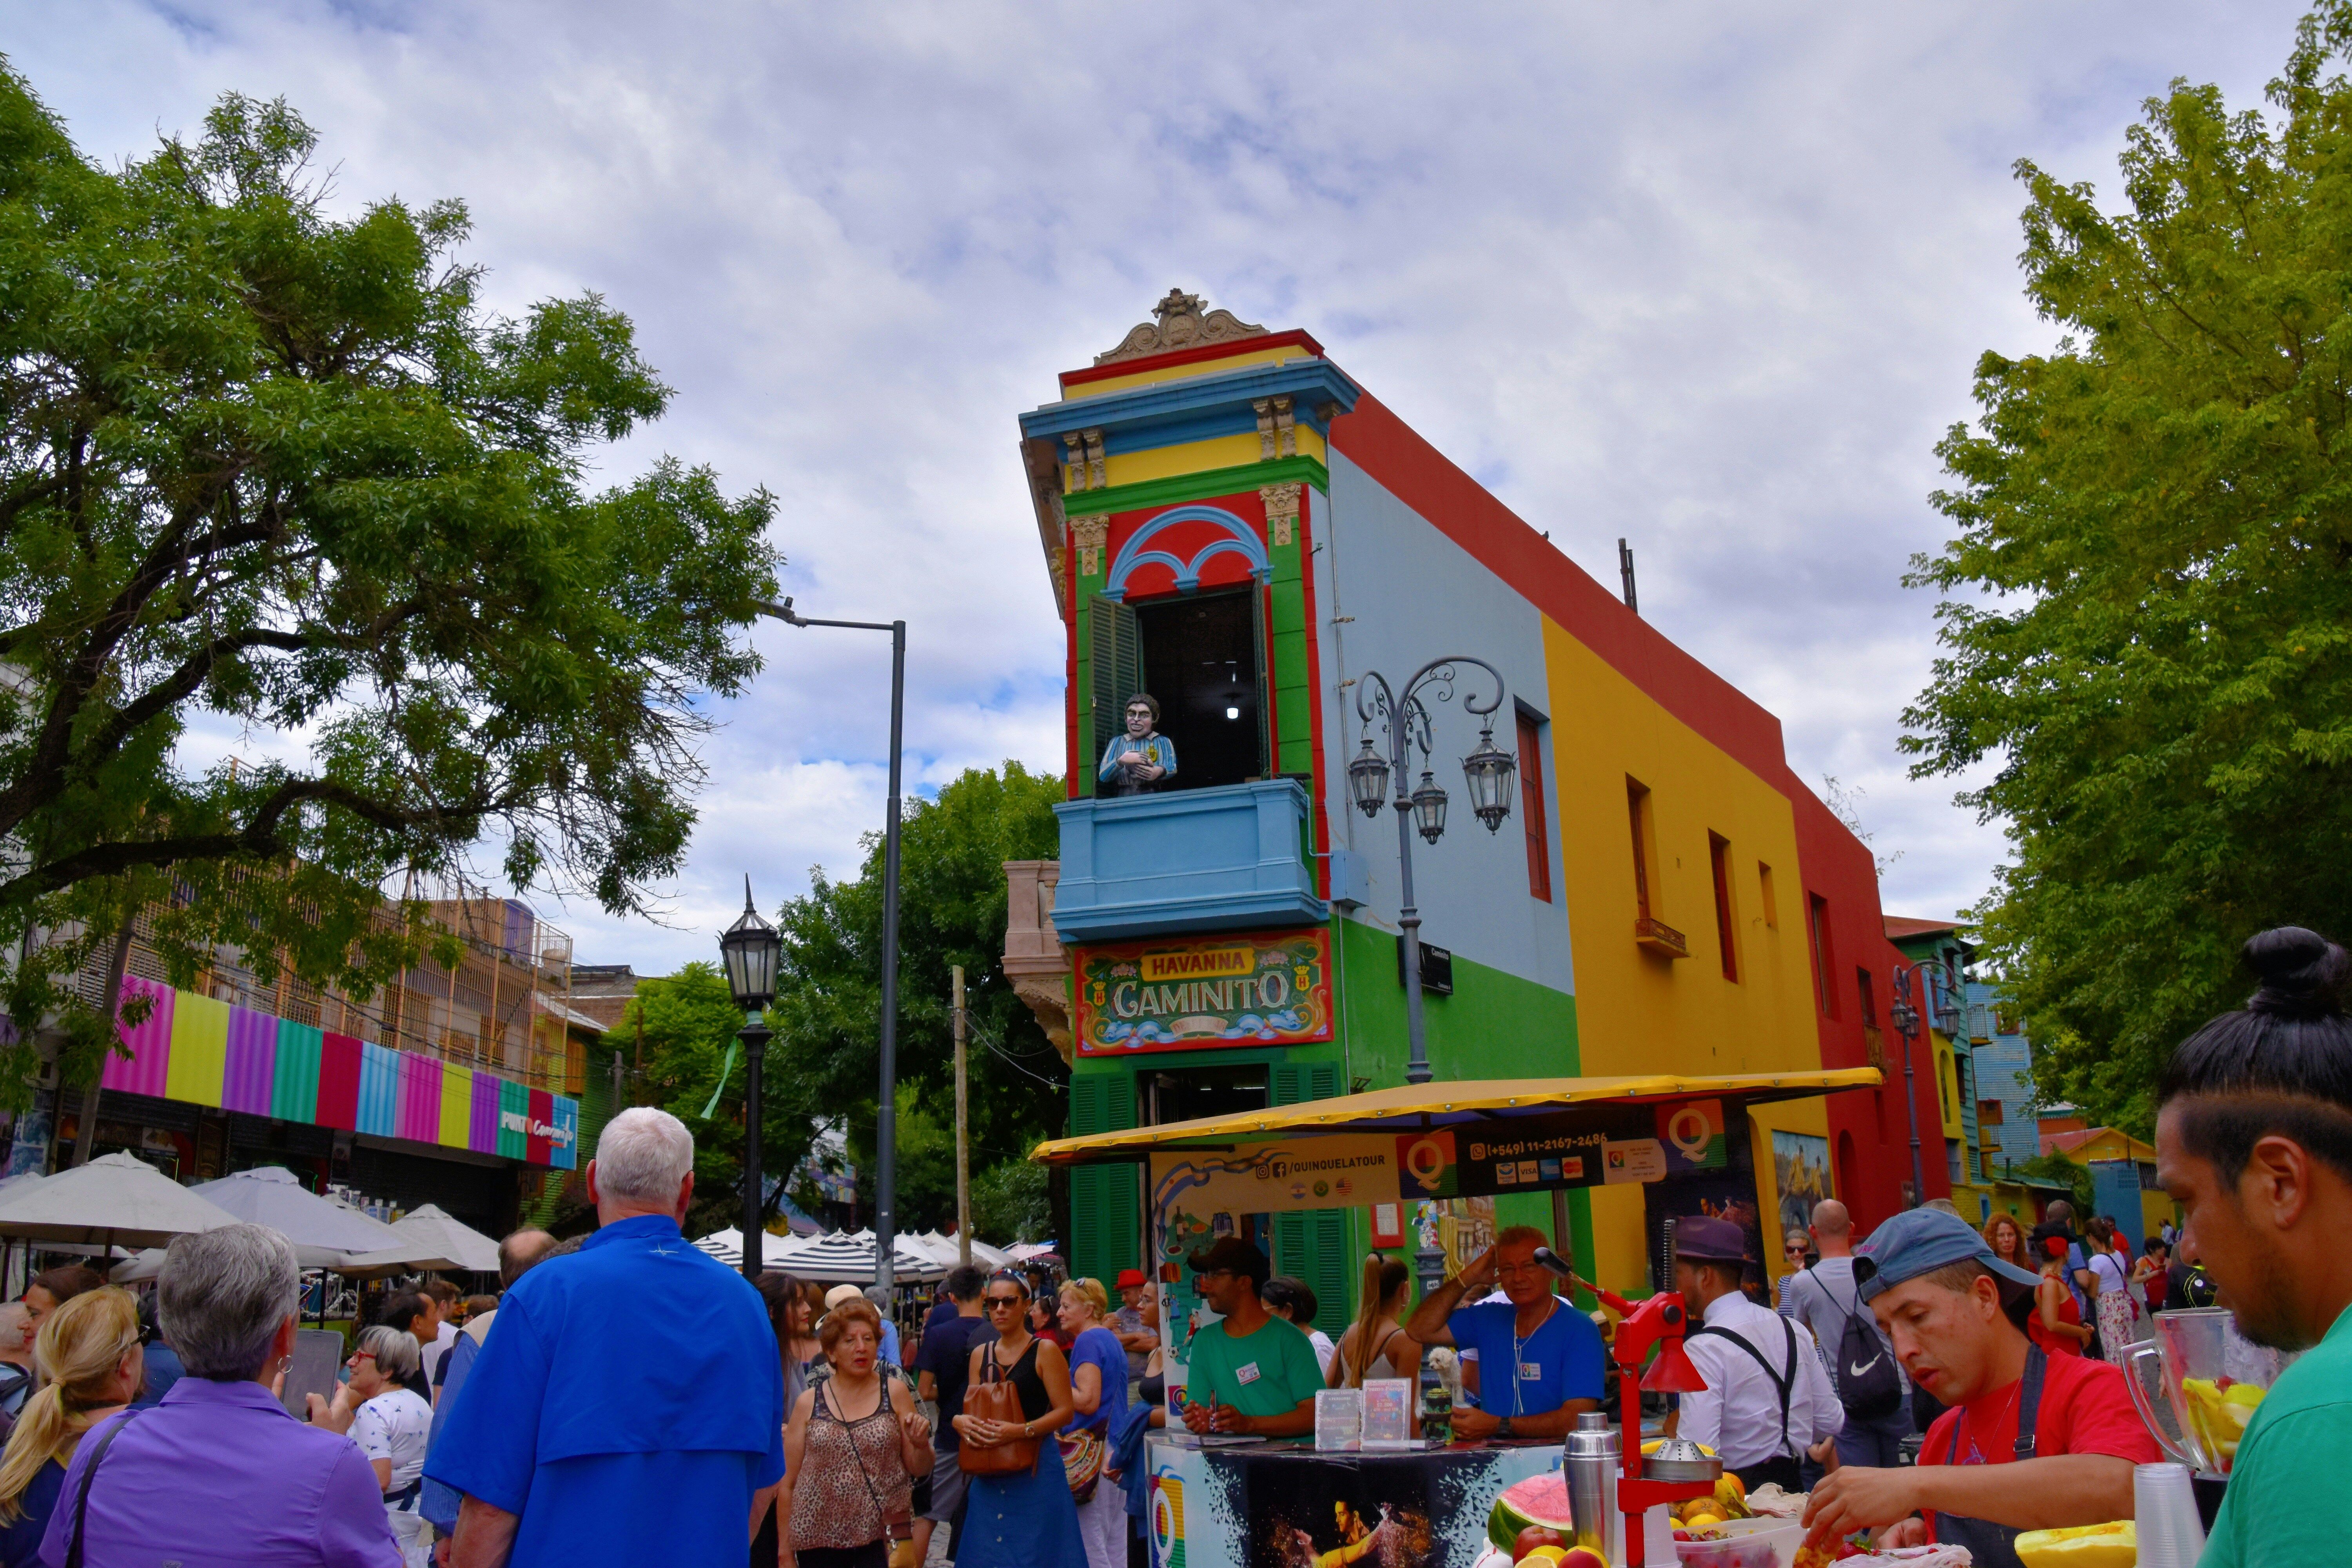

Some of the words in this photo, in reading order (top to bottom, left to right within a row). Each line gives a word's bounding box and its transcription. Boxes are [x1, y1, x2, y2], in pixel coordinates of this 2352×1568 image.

[1152, 952, 1245, 976] HAVANNA
[1113, 970, 1289, 1018] CAMINITO
[1487, 1140, 1524, 1156] (+549)
[1527, 1132, 1607, 1151] 11-2167-2486
[1289, 1155, 1385, 1174] /QUINQUELATOUR
